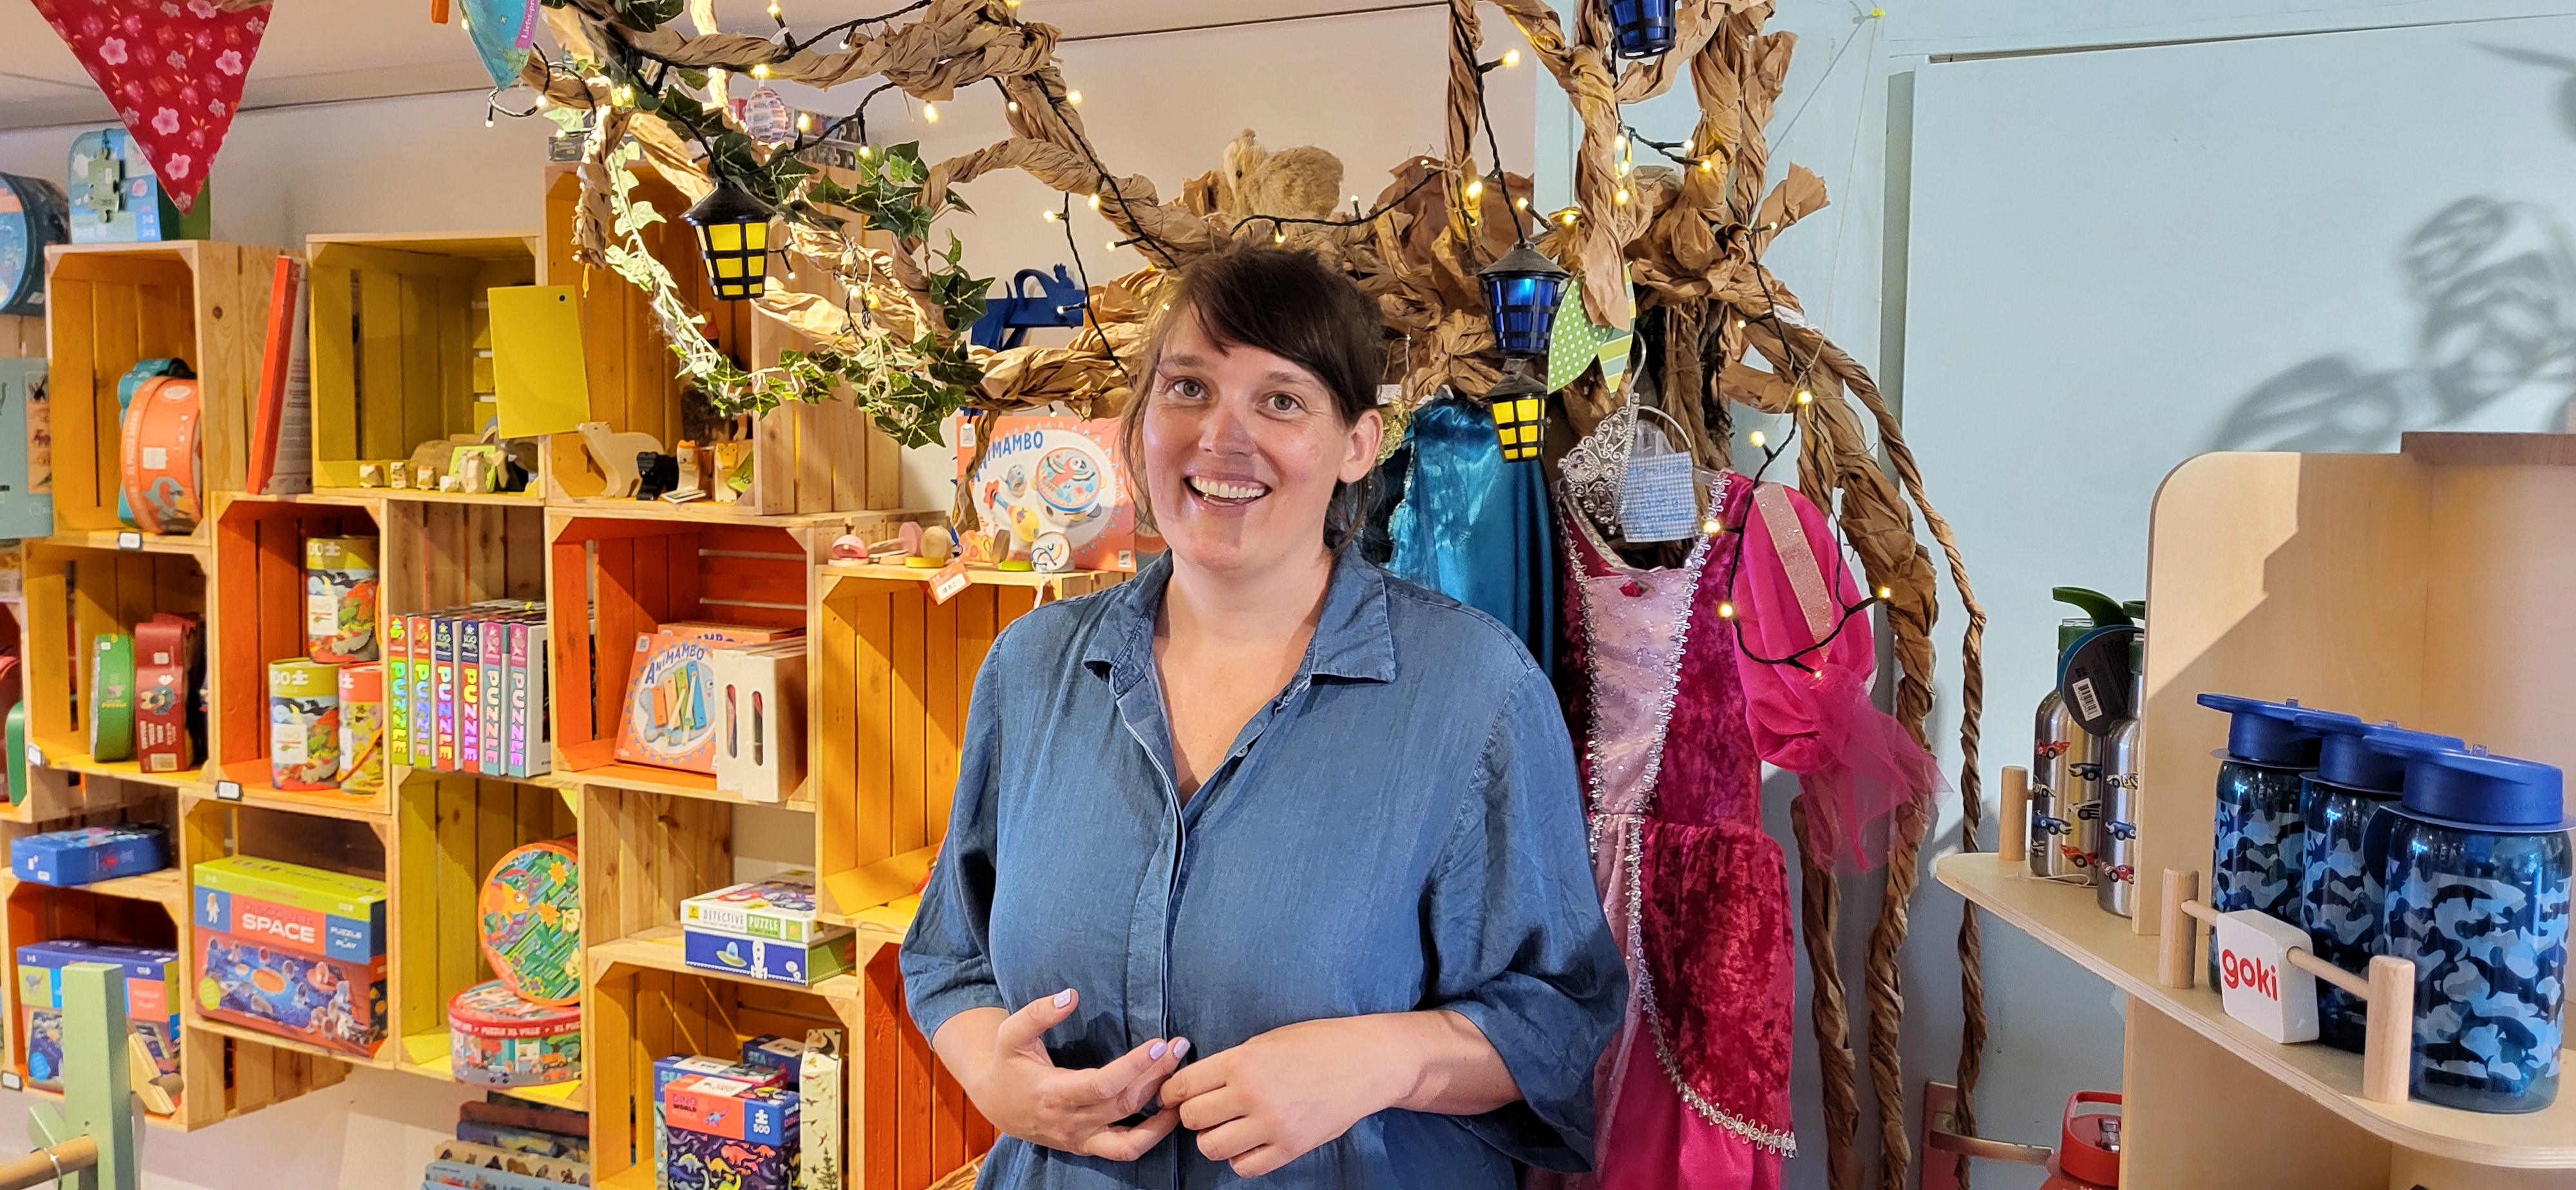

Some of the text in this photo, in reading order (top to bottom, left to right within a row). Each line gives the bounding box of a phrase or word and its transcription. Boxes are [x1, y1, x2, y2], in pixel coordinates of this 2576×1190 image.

[391, 661, 407, 753] PUZZLE
[415, 664, 430, 756] PUZZLE
[437, 666, 453, 760] PUZZLE
[464, 668, 478, 762] PUZZLE
[485, 670, 499, 764] PUZZLE
[511, 672, 525, 766] PUZZLE
[242, 912, 316, 943] SPACE
[243, 902, 314, 926] DISCOVER
[704, 909, 744, 925] DETECTIVE
[749, 916, 779, 930] PUZZLE
[330, 926, 363, 940] PUZZLE
[336, 940, 357, 949] PLAY
[2222, 949, 2278, 1001] goki
[672, 1093, 697, 1106] DINO
[673, 1104, 697, 1113] WORLD
[753, 1124, 770, 1135] 500
